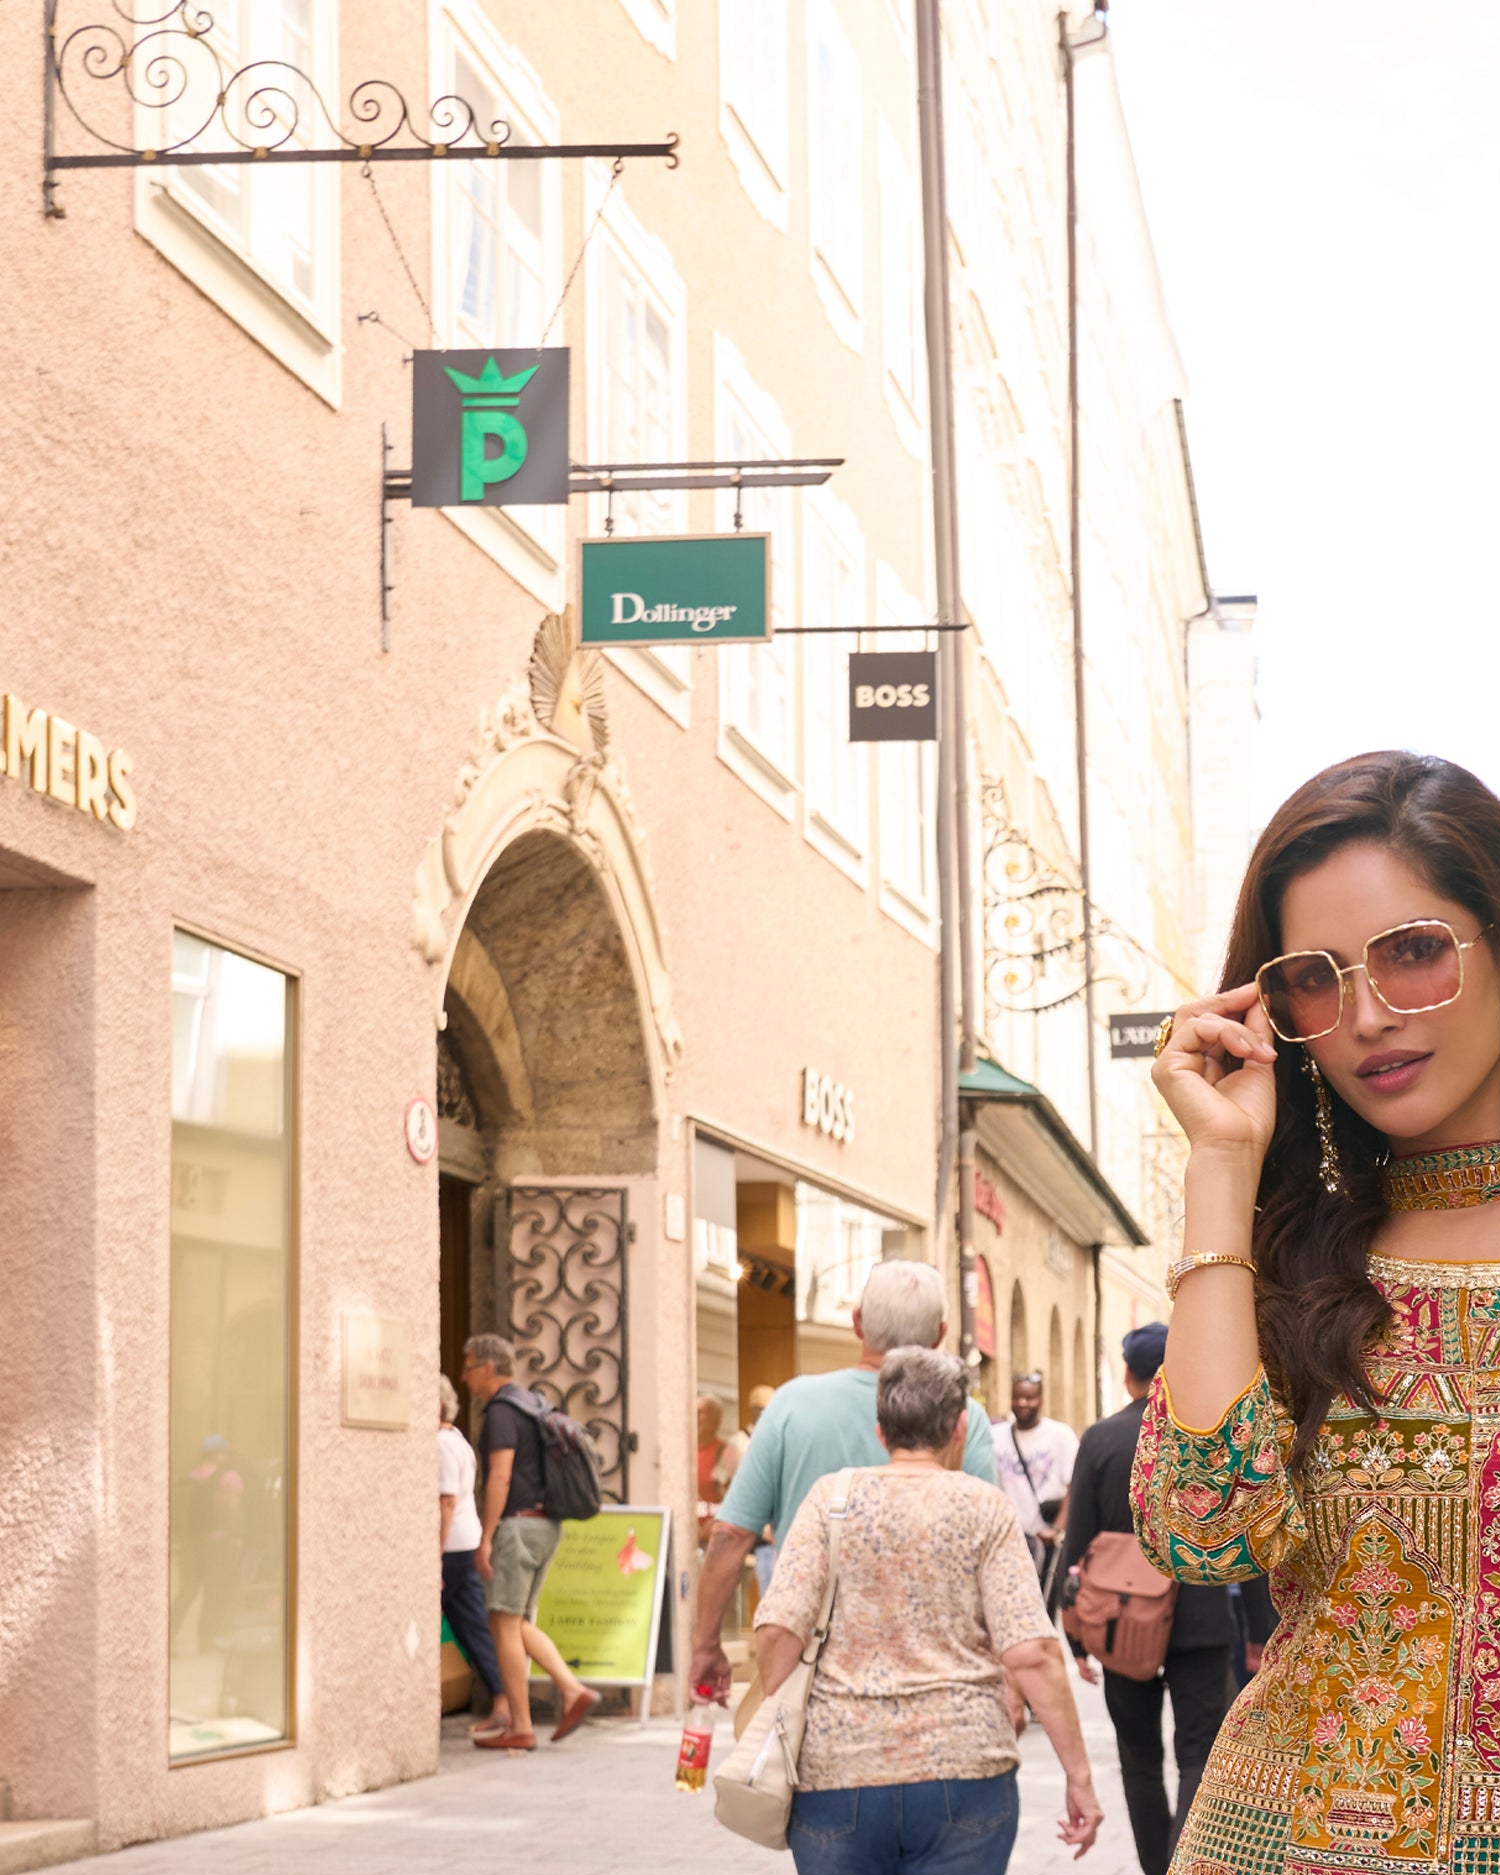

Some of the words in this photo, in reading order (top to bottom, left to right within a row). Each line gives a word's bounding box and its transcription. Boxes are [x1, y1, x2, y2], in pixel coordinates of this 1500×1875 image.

[610, 592, 738, 633] Dollinger
[854, 683, 931, 709] BOSS
[0, 693, 138, 832] MERS
[801, 1066, 856, 1146] BOSS
